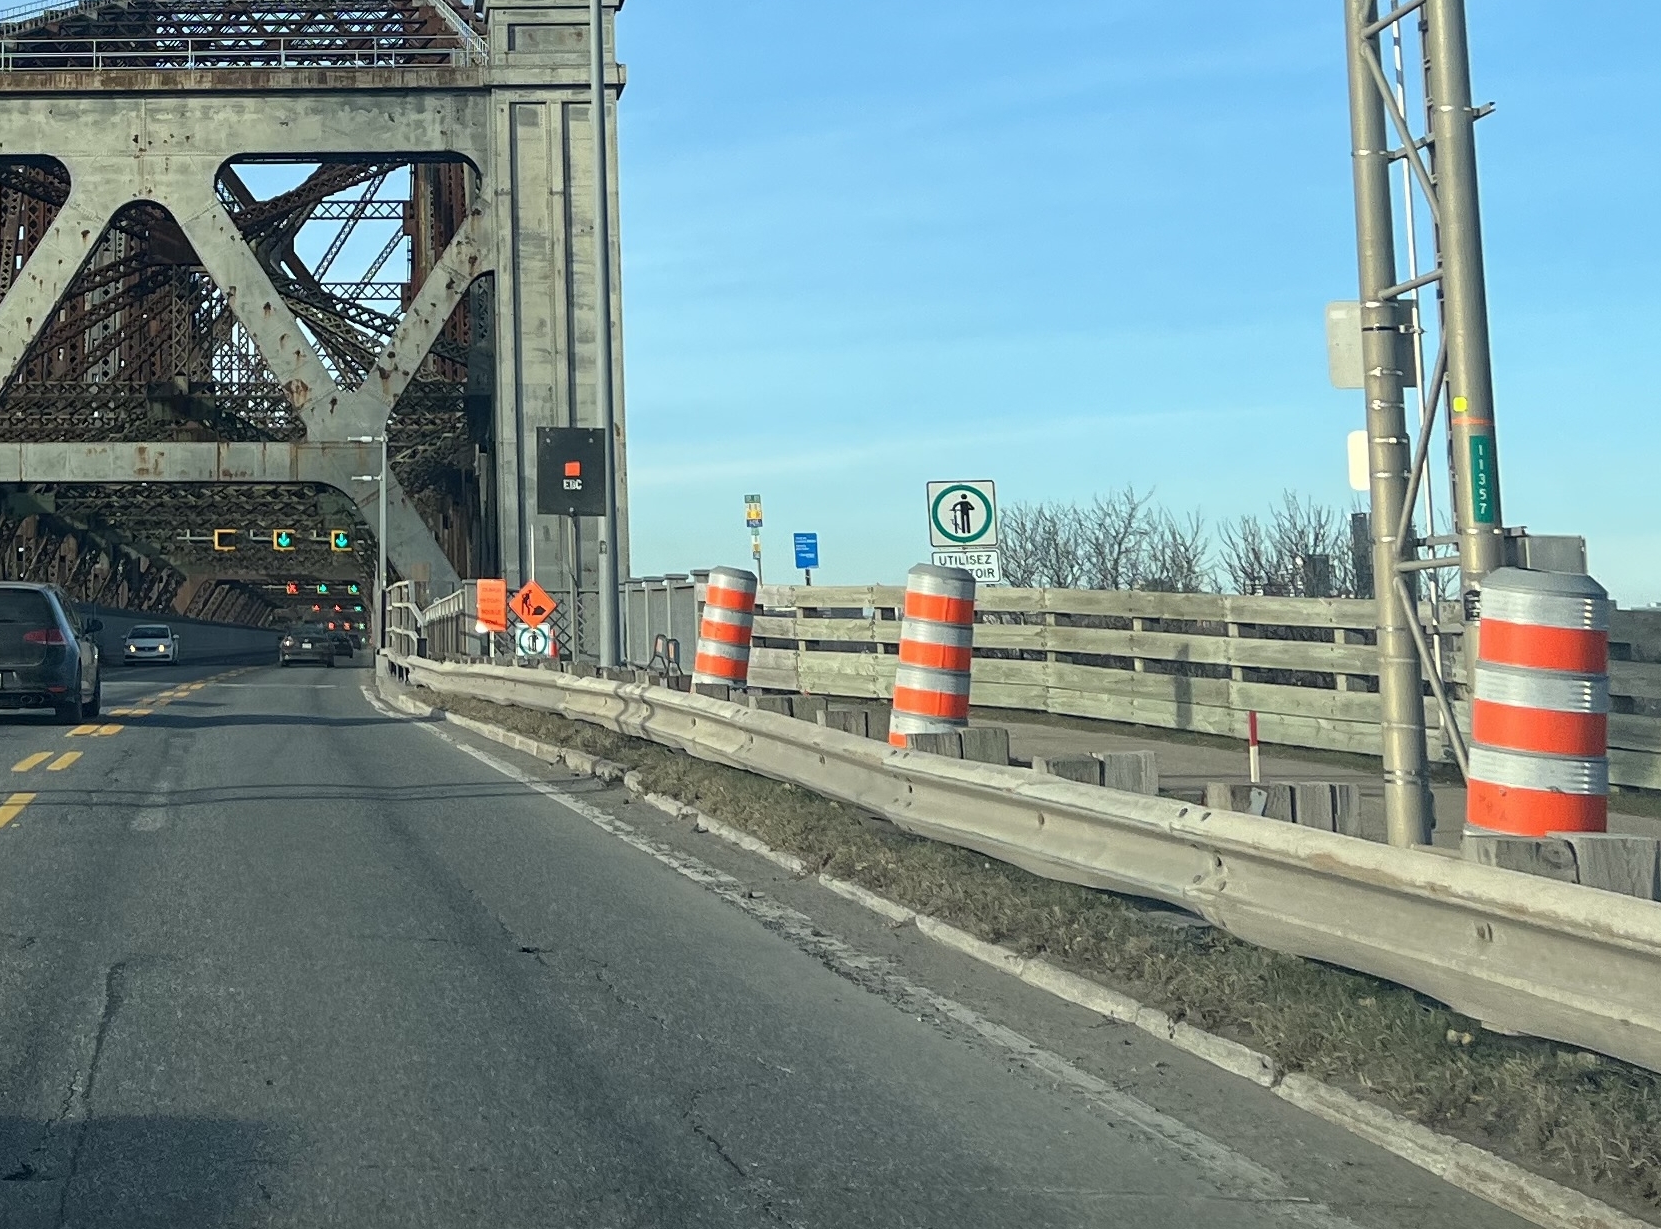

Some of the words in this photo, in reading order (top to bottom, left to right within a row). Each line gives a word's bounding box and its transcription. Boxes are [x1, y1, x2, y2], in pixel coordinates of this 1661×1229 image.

[1478, 444, 1487, 514] 11357
[938, 554, 992, 566] UTILISEZ
[968, 567, 996, 579] TOIR
